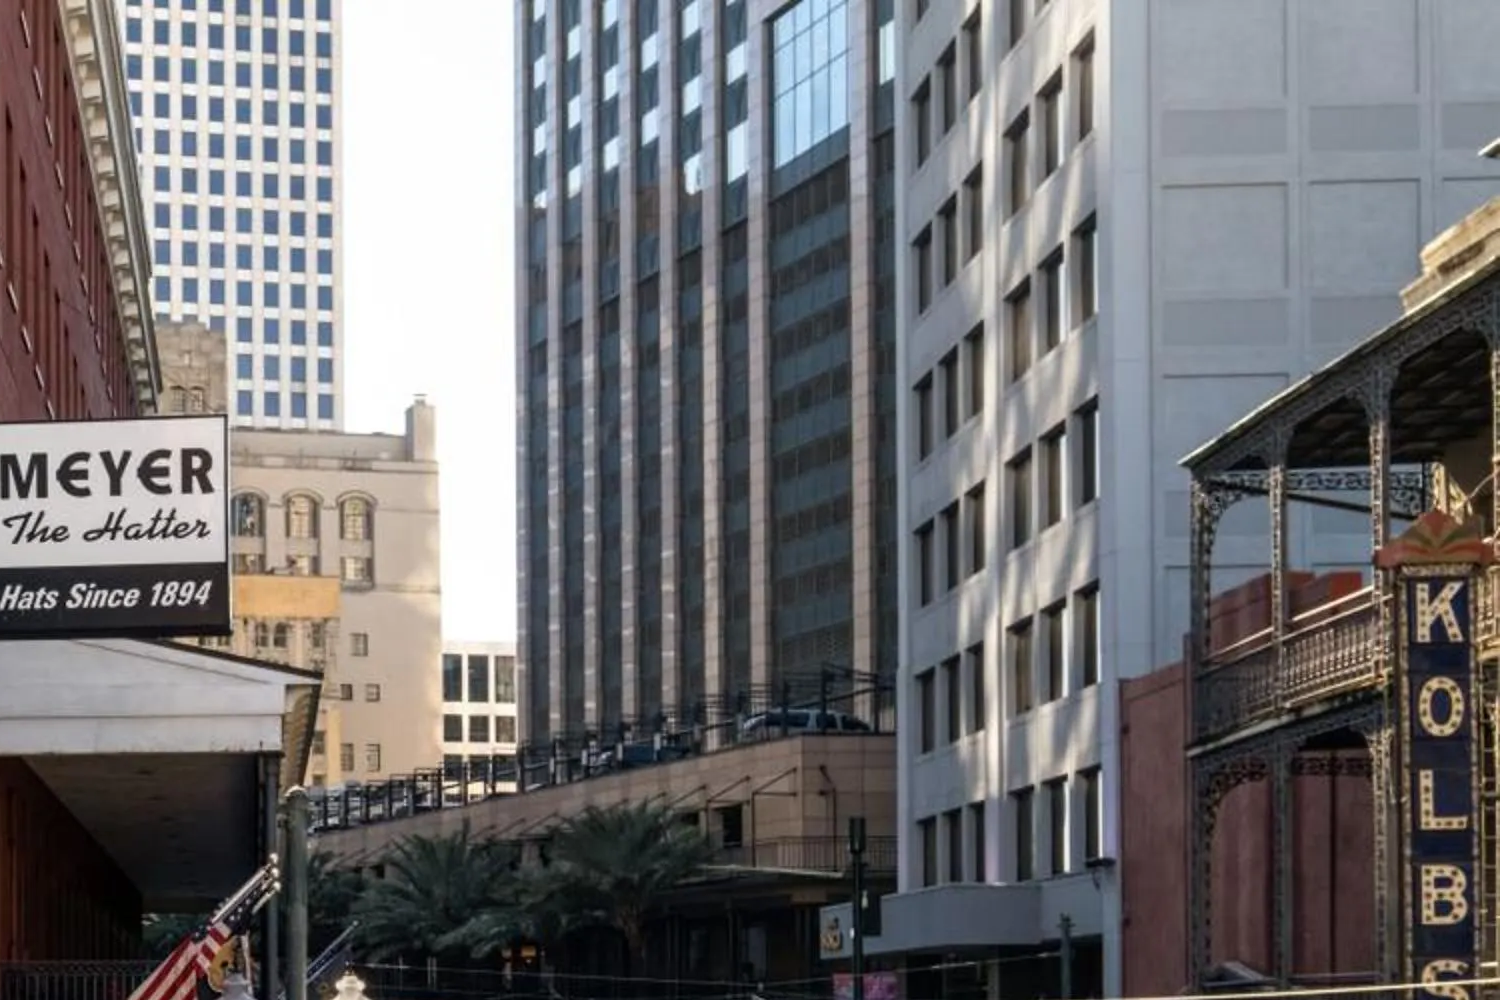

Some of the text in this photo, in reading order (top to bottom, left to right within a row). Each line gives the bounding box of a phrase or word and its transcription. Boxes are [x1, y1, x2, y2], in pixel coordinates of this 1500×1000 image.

[0, 447, 215, 500] MEYER
[2, 507, 212, 545] The Hatter
[0, 583, 59, 611] Hats
[65, 582, 140, 610] Since
[150, 580, 212, 606] 1894
